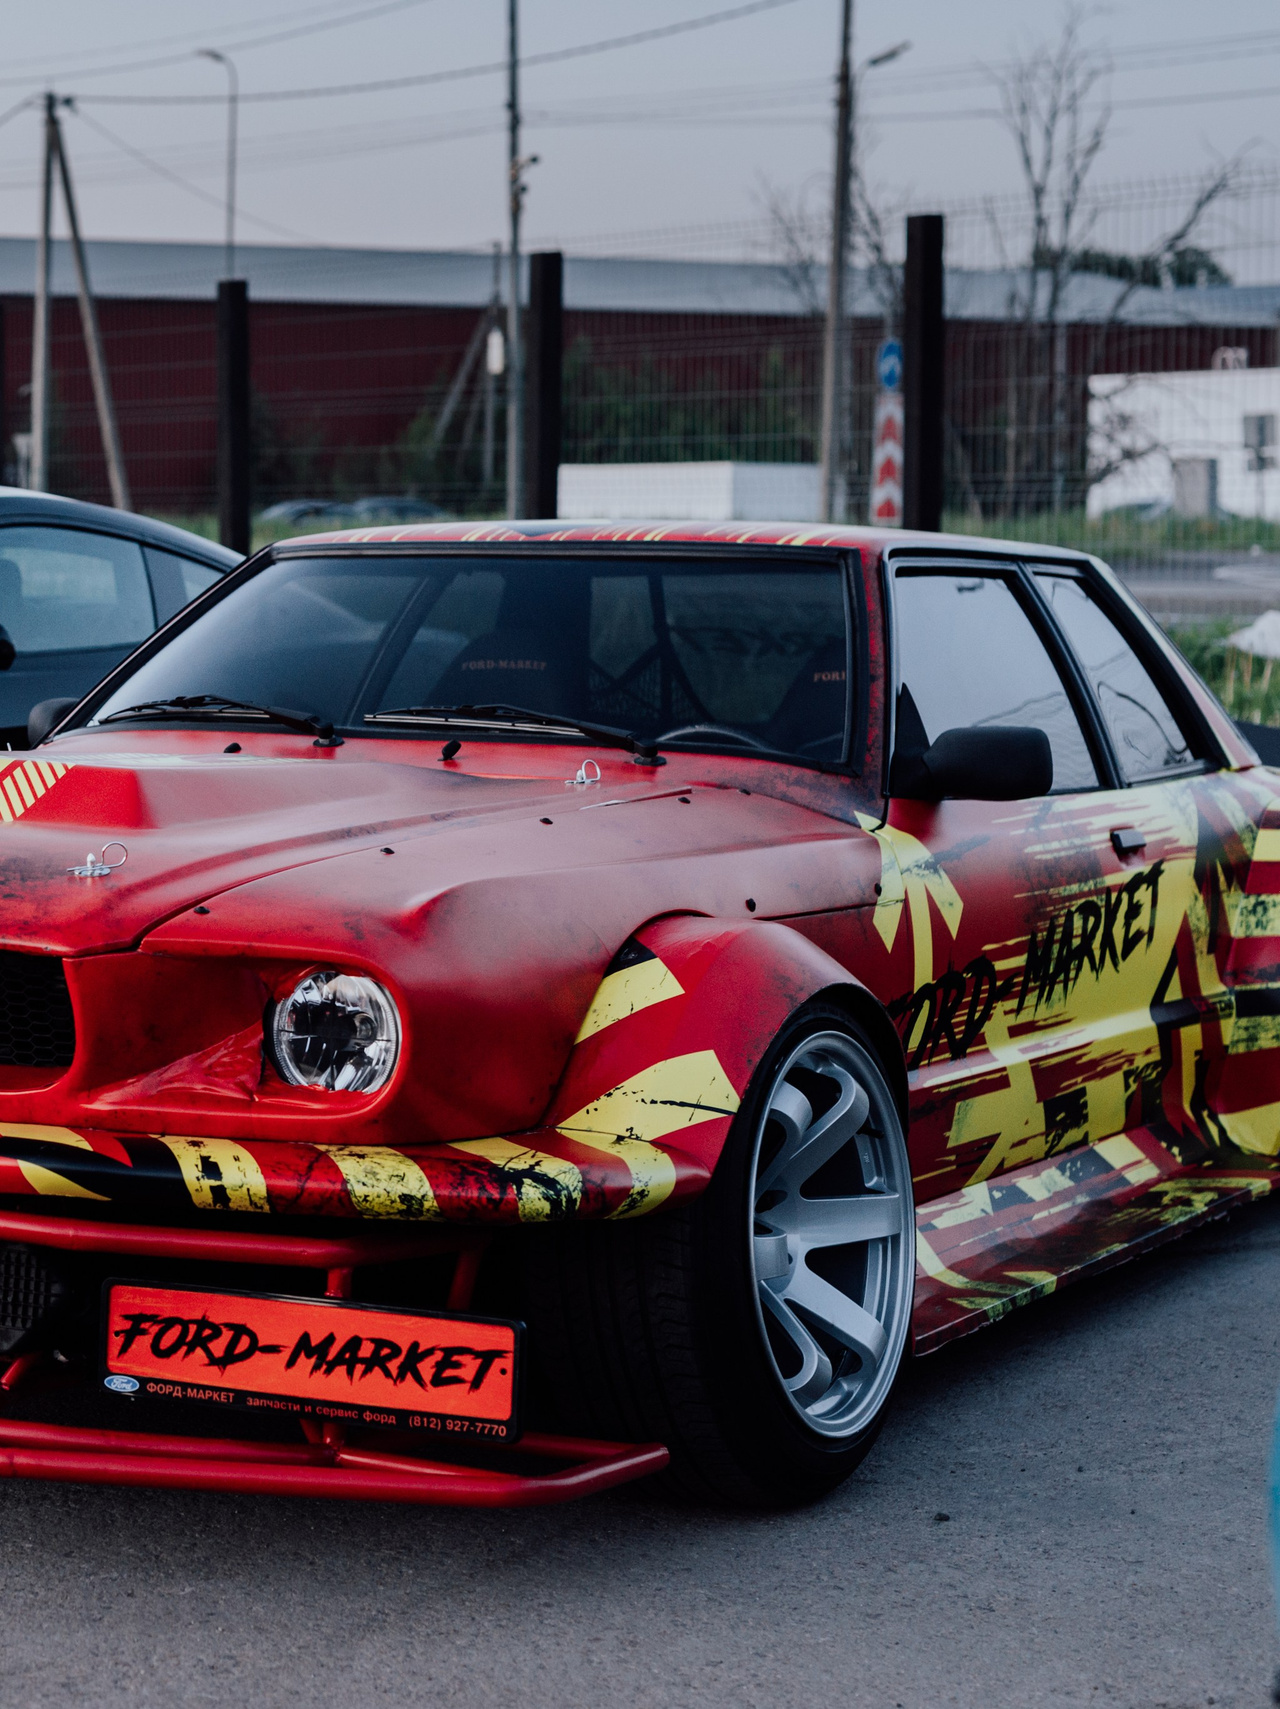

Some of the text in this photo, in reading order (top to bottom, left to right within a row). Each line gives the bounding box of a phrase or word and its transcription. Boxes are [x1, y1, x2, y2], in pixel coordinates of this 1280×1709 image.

[116, 1311, 514, 1394] FORD-MARKET
[146, 1382, 235, 1404] ФОРД-МАРКЕТ
[246, 1397, 300, 1412] запчасти
[316, 1406, 359, 1419] сервис
[363, 1410, 396, 1424] форд
[409, 1415, 441, 1431] (812)
[446, 1419, 507, 1437] 927-7770
